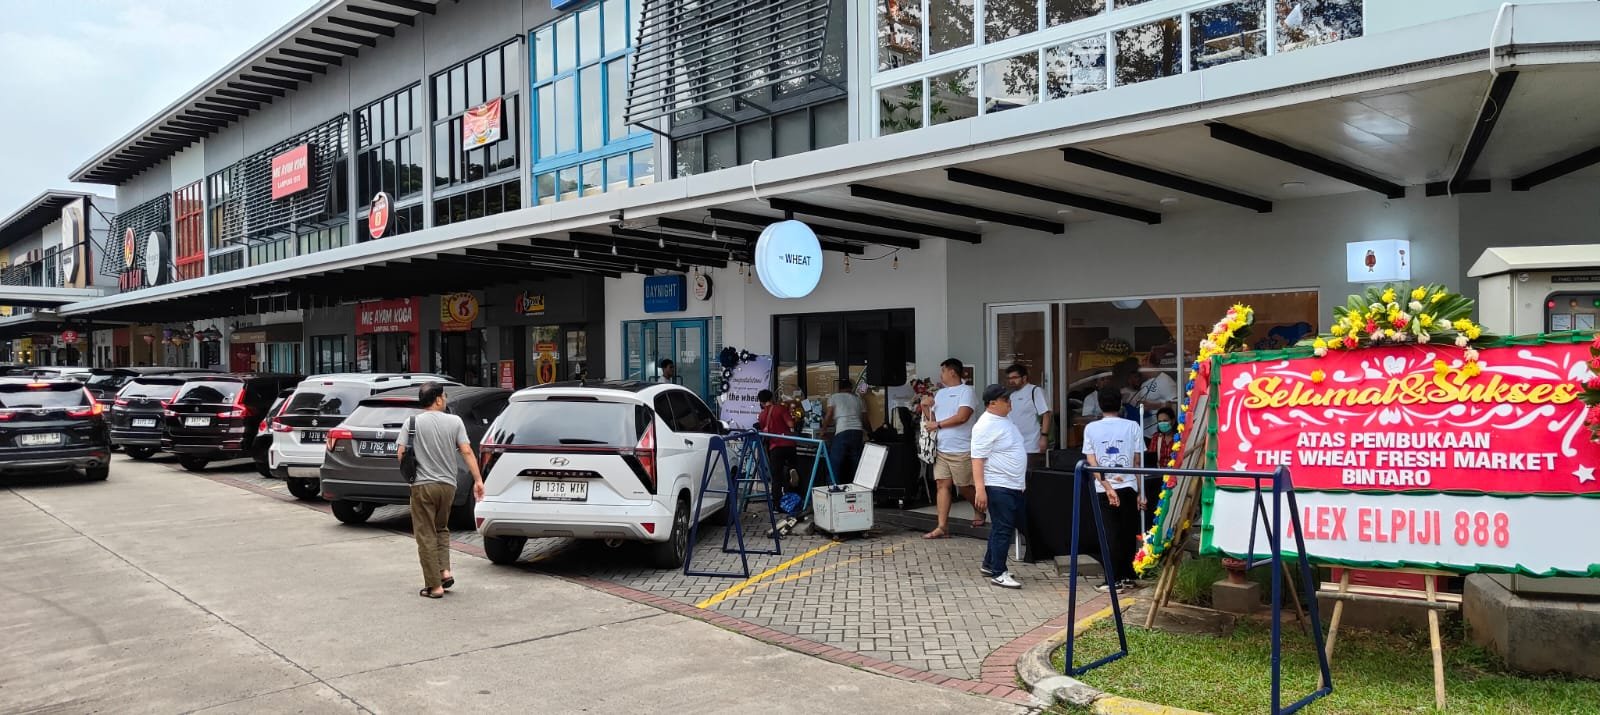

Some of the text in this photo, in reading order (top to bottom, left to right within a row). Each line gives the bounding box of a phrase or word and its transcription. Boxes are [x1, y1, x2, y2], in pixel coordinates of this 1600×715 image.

[785, 253, 811, 266] WHEAT
[646, 283, 677, 298] DAYNIGHT
[362, 307, 412, 325] MIE AYAM KOGA
[728, 392, 759, 403] the whea
[1296, 432, 1491, 449] ATAS PEMBUKAAN
[1254, 450, 1558, 471] THE WHEAT FRESH MARKET
[1342, 469, 1431, 486] BINTARO
[535, 482, 585, 493] B 1316 WIK
[1358, 508, 1441, 545] ELPIJI
[1454, 511, 1510, 548] 888
